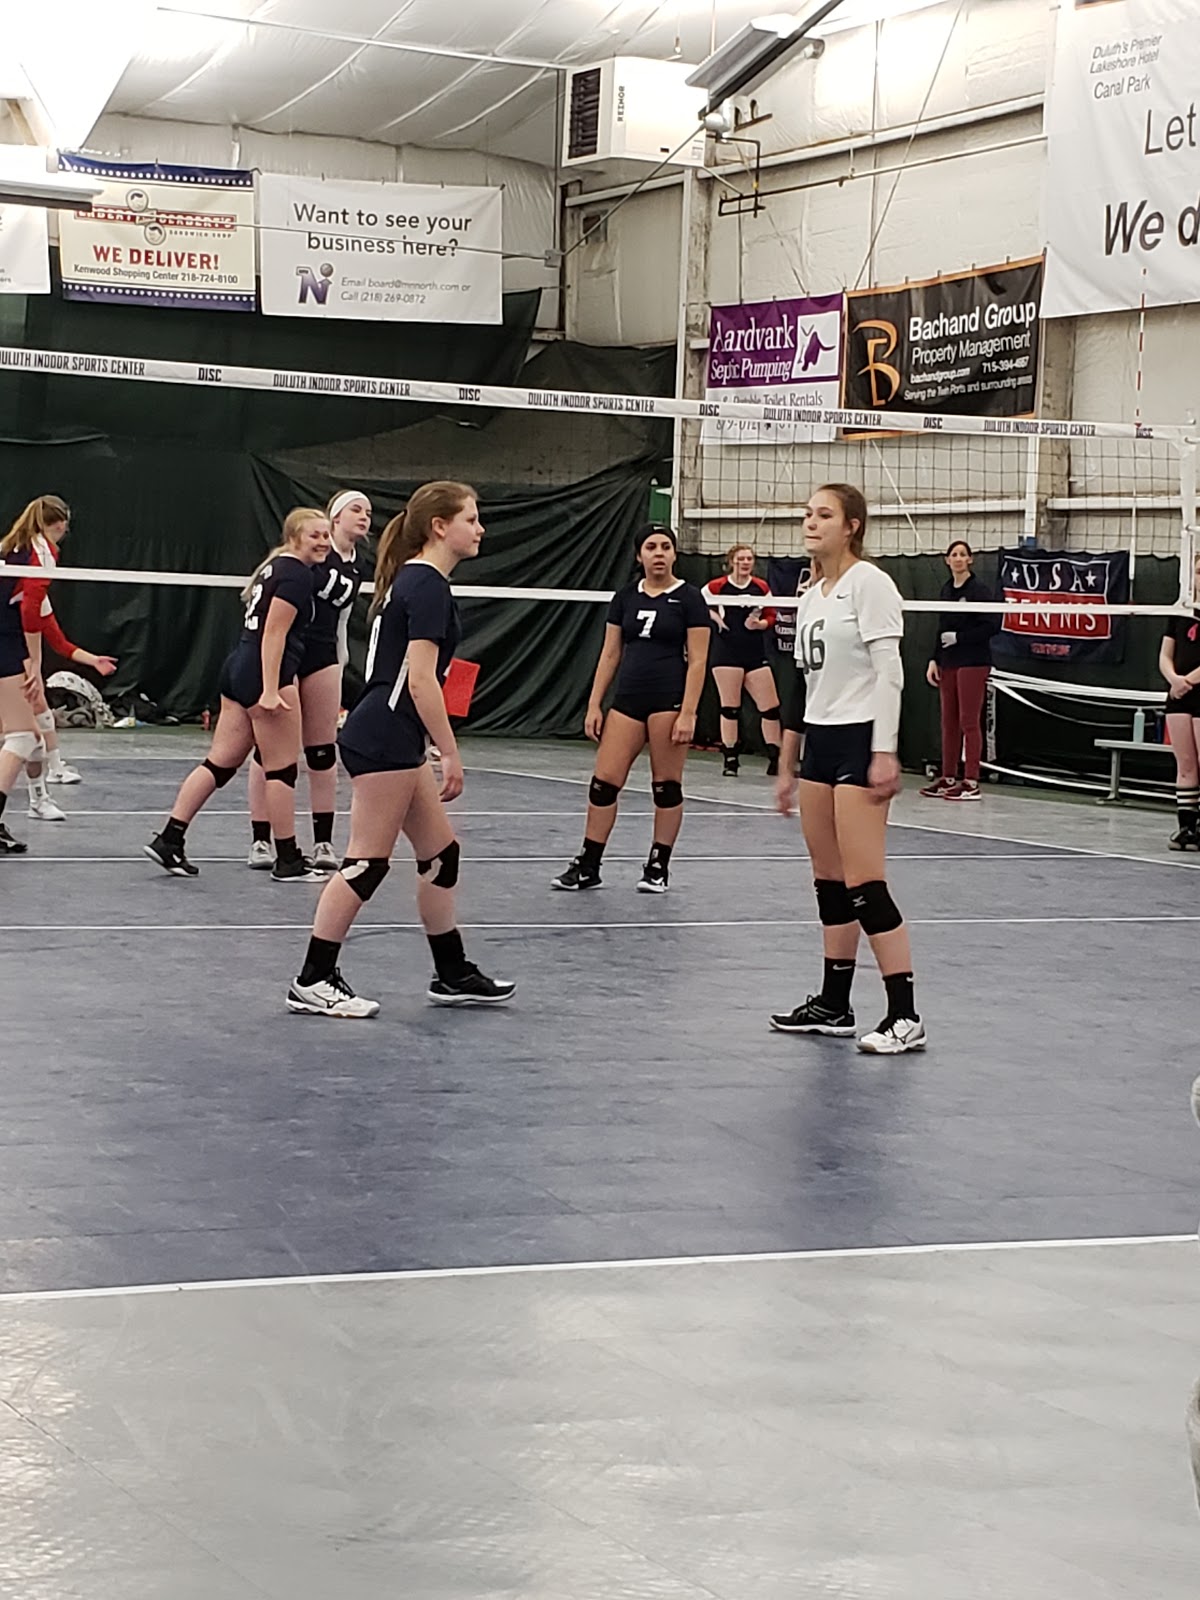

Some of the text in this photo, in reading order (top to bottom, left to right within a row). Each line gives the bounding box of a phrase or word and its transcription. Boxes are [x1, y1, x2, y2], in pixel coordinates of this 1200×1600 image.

[1090, 57, 1136, 74] Lakeshore
[1094, 73, 1151, 99] Canal Park
[1144, 102, 1196, 155] Let
[293, 202, 472, 235] Want to see your
[1105, 200, 1164, 256] We
[307, 232, 459, 257] business here?
[92, 245, 219, 270] WE DELIVER!
[74, 263, 238, 284] Kenwood Shopping Center 218-724-8100
[341, 277, 366, 287] Email
[461, 284, 471, 292] or
[341, 291, 359, 301] Call
[711, 313, 795, 352] Aardvark
[909, 301, 1036, 341] Bachand Group
[912, 330, 1031, 367] Property Management
[0, 351, 145, 376] ULUTH INDOOR SPORTS CENTER
[197, 367, 222, 382] DISC
[711, 355, 792, 385] Septic Pumping
[273, 373, 410, 396] DULUTH INDOOR SPORTS CENTER
[458, 387, 481, 401] DISC
[904, 390, 926, 401] Serving
[967, 381, 980, 392] and
[527, 391, 655, 412] DULUTH INDOOR SPORTS CENTER
[699, 403, 720, 416] DISC
[789, 390, 823, 406] Rentals
[763, 407, 882, 426] DULUTH INDOOR SPORTS CENTER
[923, 416, 943, 429] DISC
[1040, 422, 1068, 436] SPORTS
[1069, 424, 1096, 437] CENTER
[317, 568, 354, 607] 17
[636, 609, 657, 638] 7
[800, 618, 825, 675] 16
